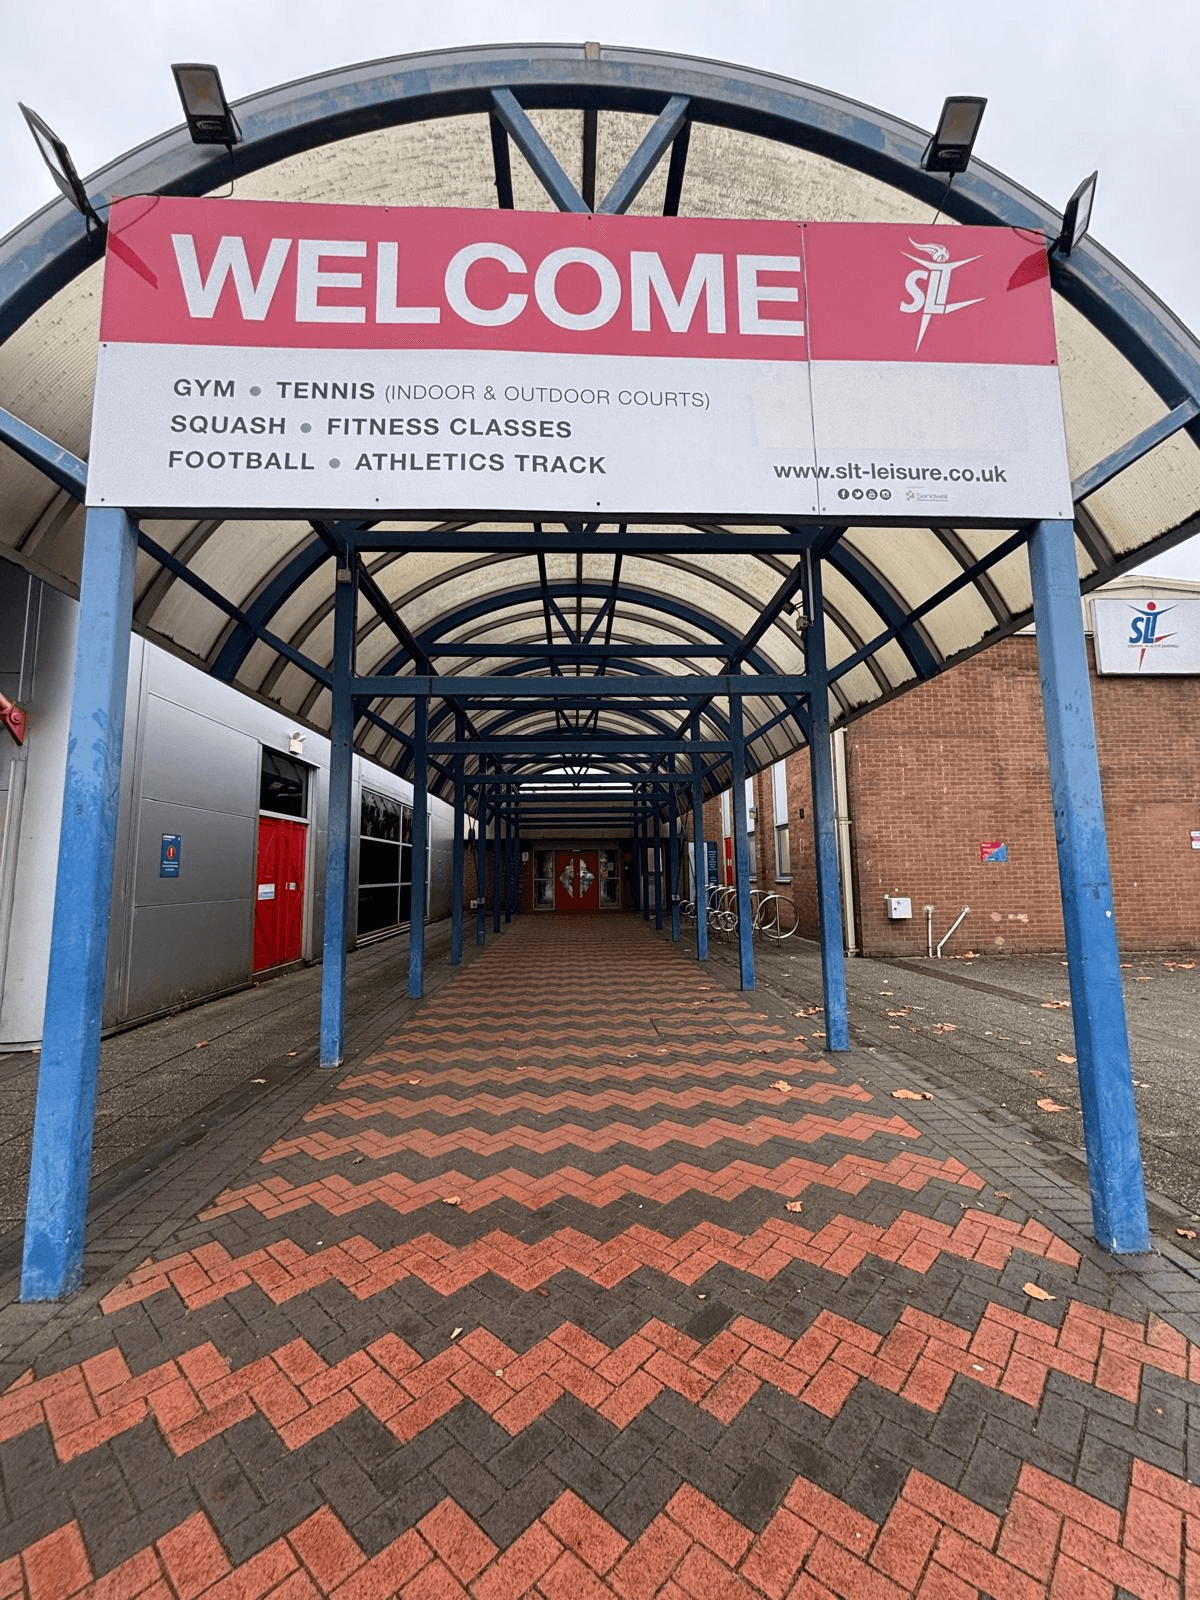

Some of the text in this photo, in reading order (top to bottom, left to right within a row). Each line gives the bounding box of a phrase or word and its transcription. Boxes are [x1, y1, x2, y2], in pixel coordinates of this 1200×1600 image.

[170, 233, 805, 337] WELCOME
[174, 379, 710, 411] GYM TENNIS (INDOOR & OUTDOOR COURTS)
[171, 415, 572, 439] SQUASH FITNESS CLASSES
[169, 451, 607, 475] FOOTBALL ATHLETICS TRACK
[773, 462, 1008, 483] www.slt-leisure.co.uk
